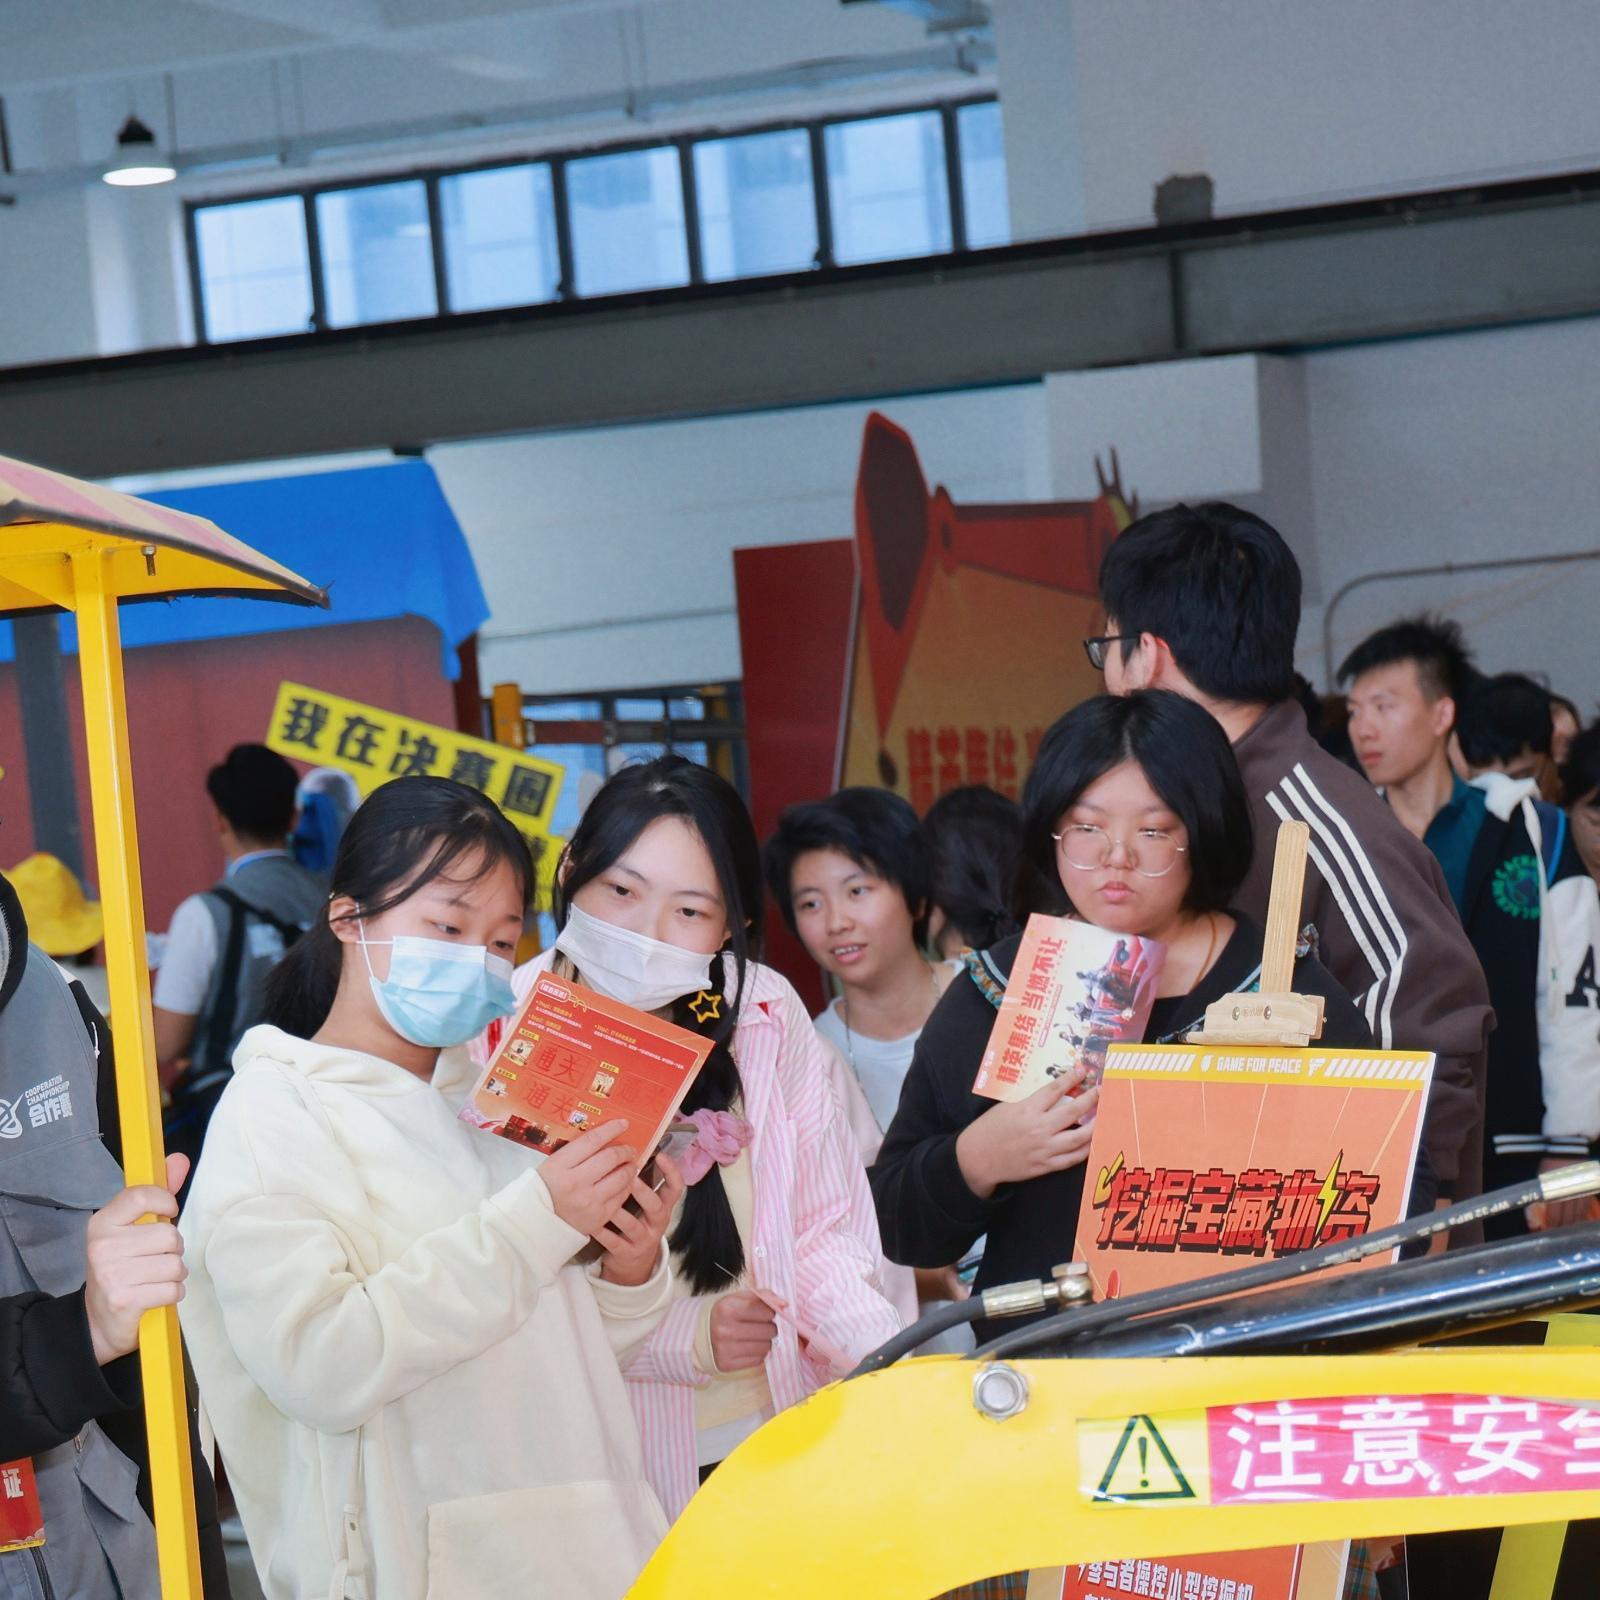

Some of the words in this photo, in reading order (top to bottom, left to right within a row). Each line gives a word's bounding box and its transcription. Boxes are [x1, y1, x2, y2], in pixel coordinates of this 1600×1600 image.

[1216, 1056, 1245, 1072] GAME
[1246, 1057, 1266, 1073] FOR
[1268, 1057, 1302, 1074] PEACE
[29, 1092, 73, 1128] 合作赛
[1097, 1167, 1382, 1258] 挖掘宝藏物资
